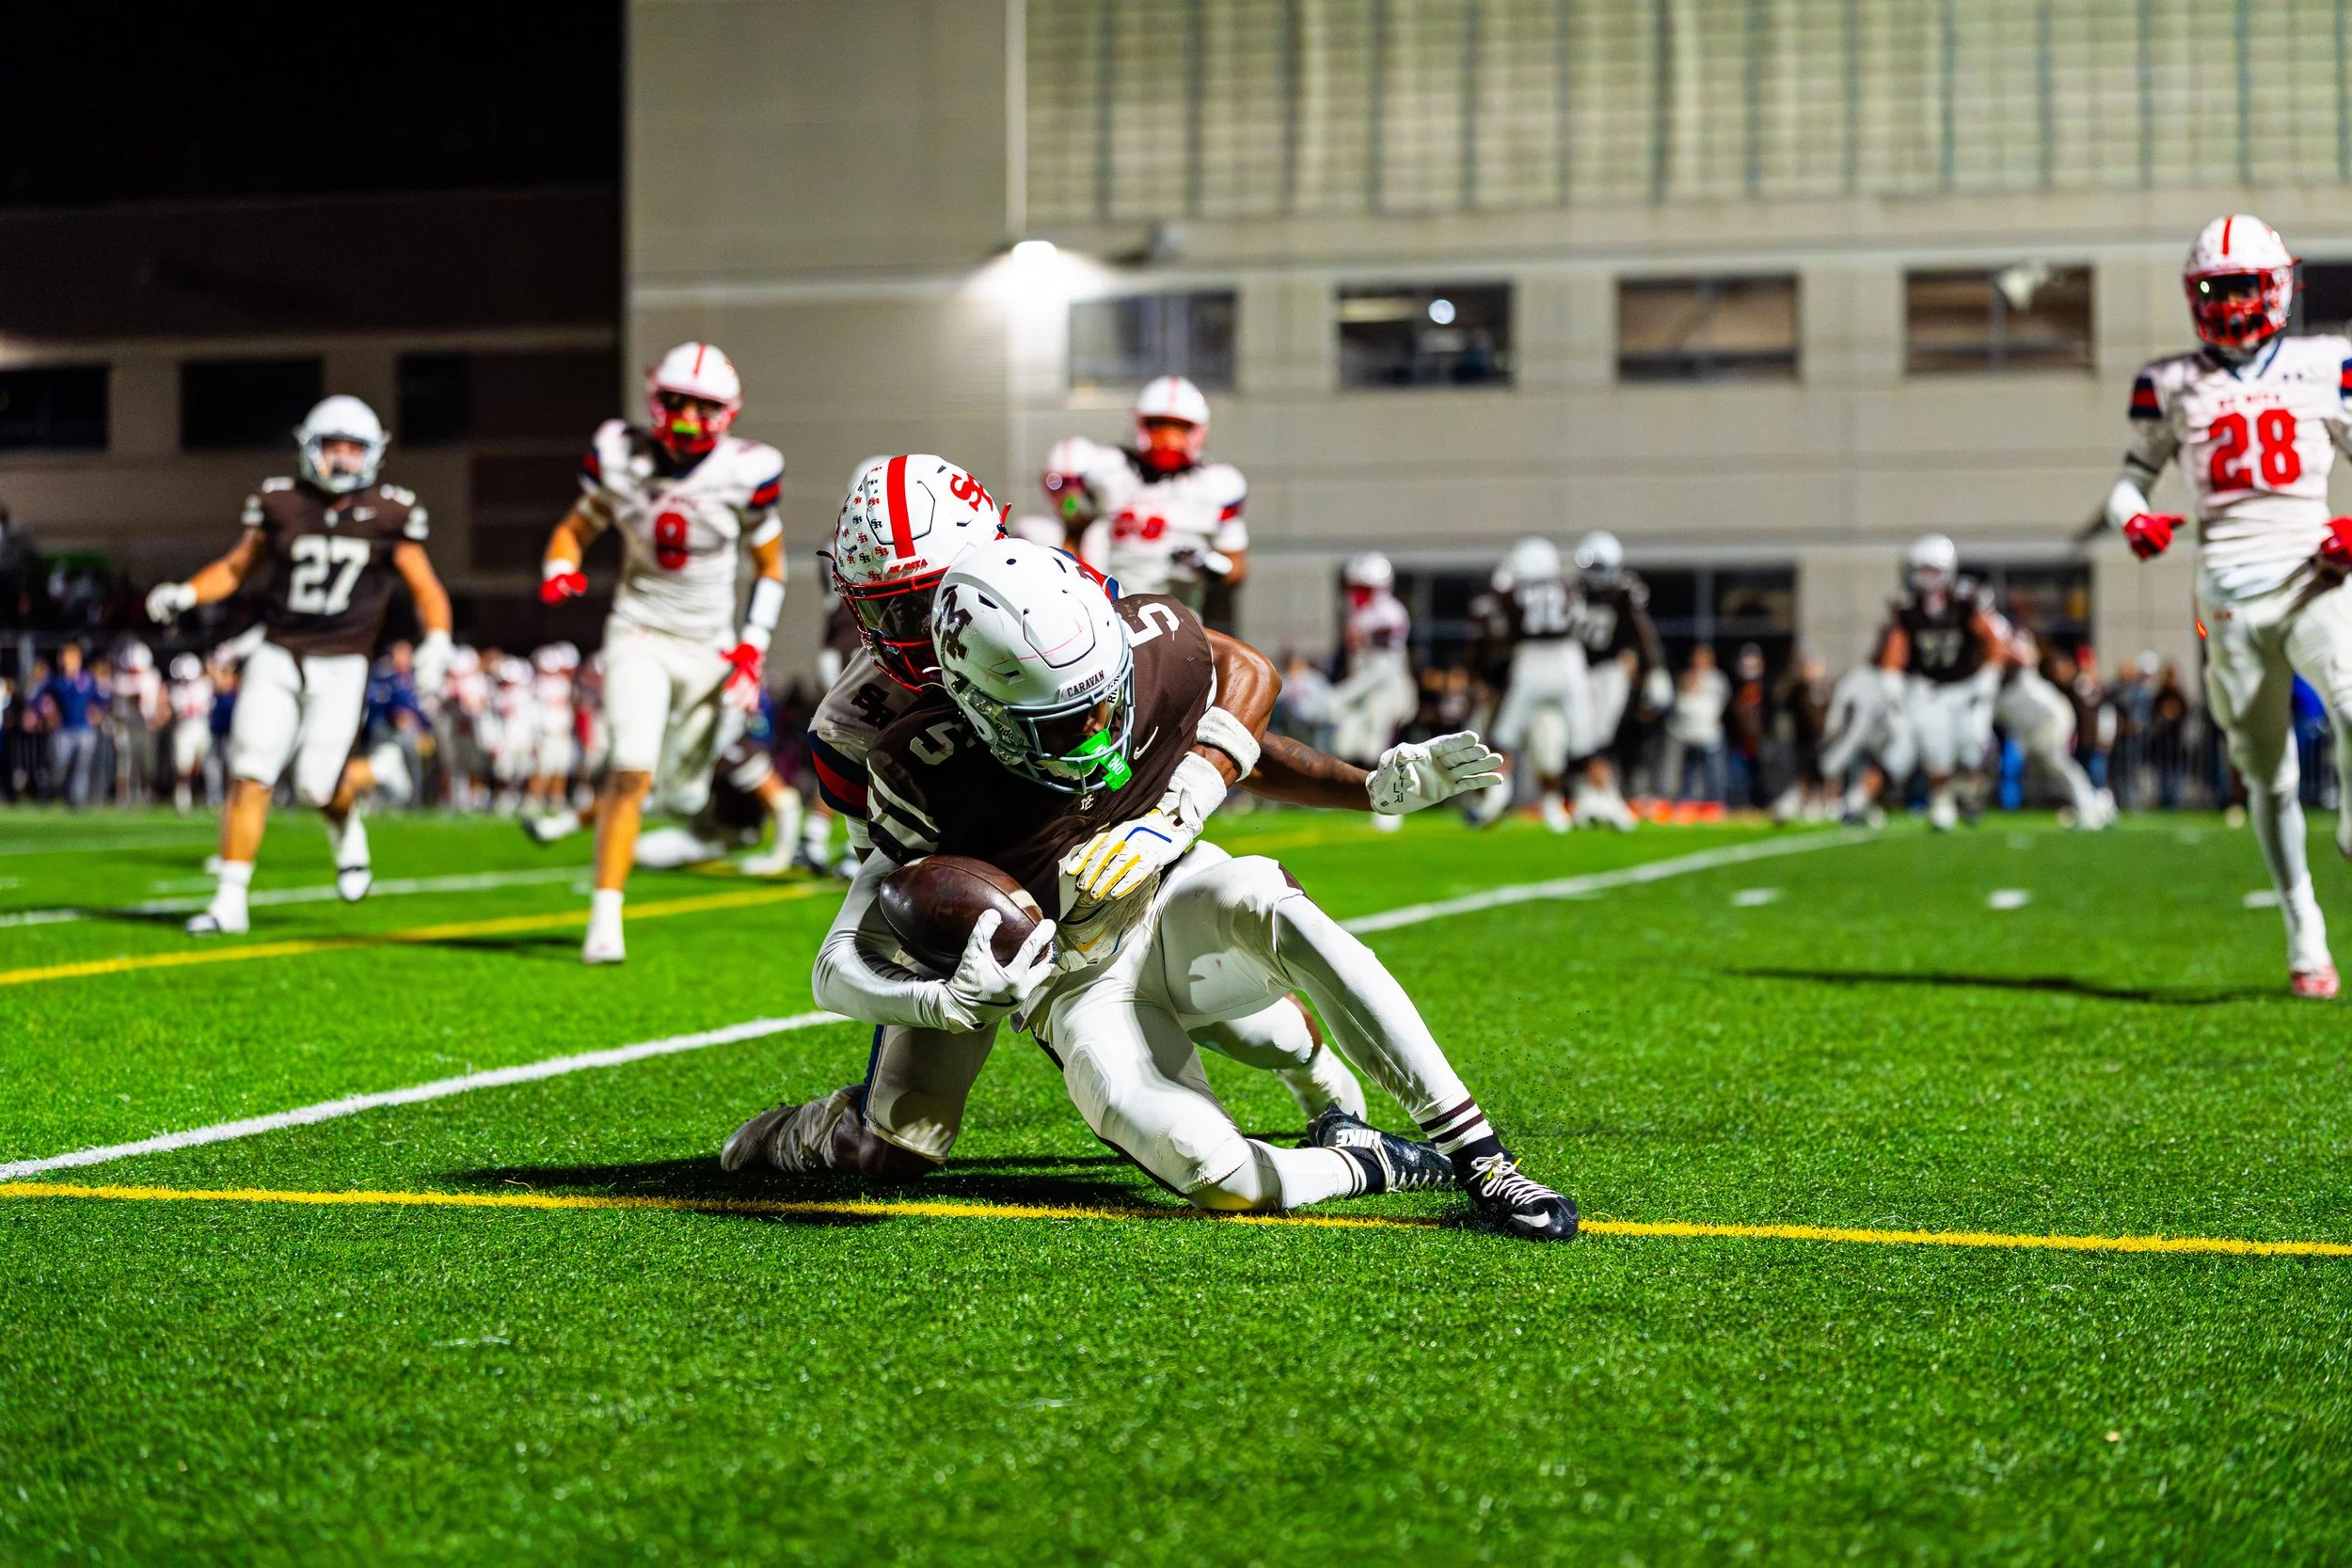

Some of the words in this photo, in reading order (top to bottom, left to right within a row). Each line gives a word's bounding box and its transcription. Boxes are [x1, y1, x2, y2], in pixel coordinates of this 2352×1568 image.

[2209, 408, 2301, 492] 28
[288, 533, 371, 617] 27
[1120, 602, 1181, 649] 5
[1066, 670, 1105, 698] CARAVAN
[909, 720, 964, 766] 5
[1335, 1128, 1381, 1148] NIKE
